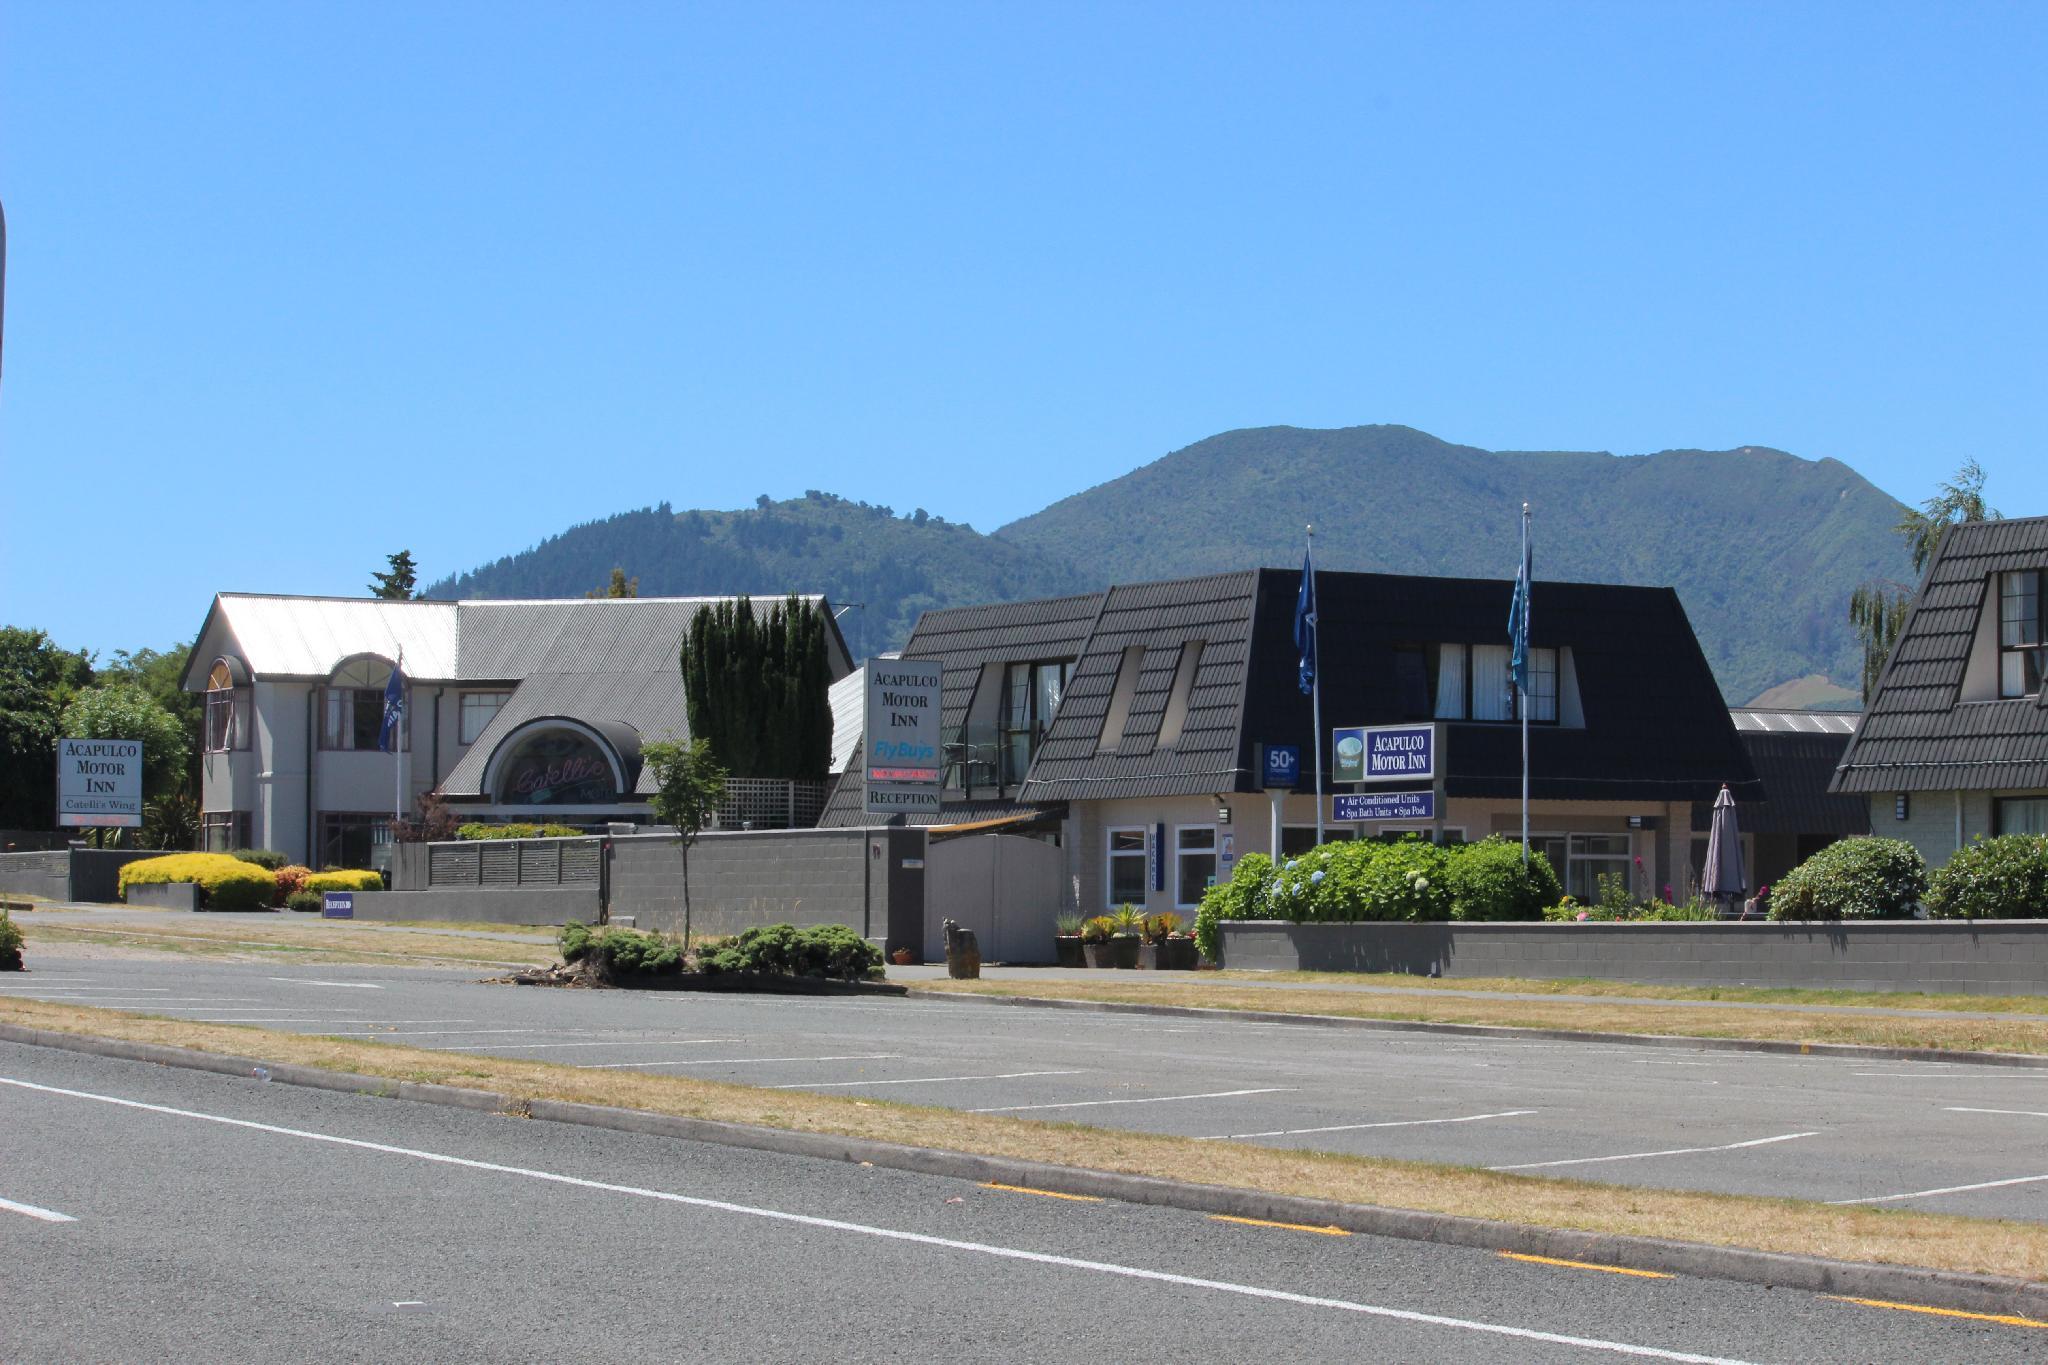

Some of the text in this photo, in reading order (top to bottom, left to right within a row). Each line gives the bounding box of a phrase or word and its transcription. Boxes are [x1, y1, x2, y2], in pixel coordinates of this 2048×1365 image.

[874, 672, 938, 687] ACAPULCO
[882, 692, 928, 708] MOTOR
[891, 713, 918, 727] INN
[66, 742, 137, 757] ACAPULCO
[1374, 735, 1424, 752] ACAPULCO
[77, 760, 125, 775] MOTOR
[1372, 754, 1405, 770] MOTOR
[1408, 752, 1426, 769] INN
[86, 778, 115, 792] INN
[870, 791, 938, 804] RECEPTION
[1348, 795, 1420, 806] Air Conditioned Units
[109, 800, 136, 811] Wing
[1347, 806, 1425, 820] Spa Bath Units Spa Pool
